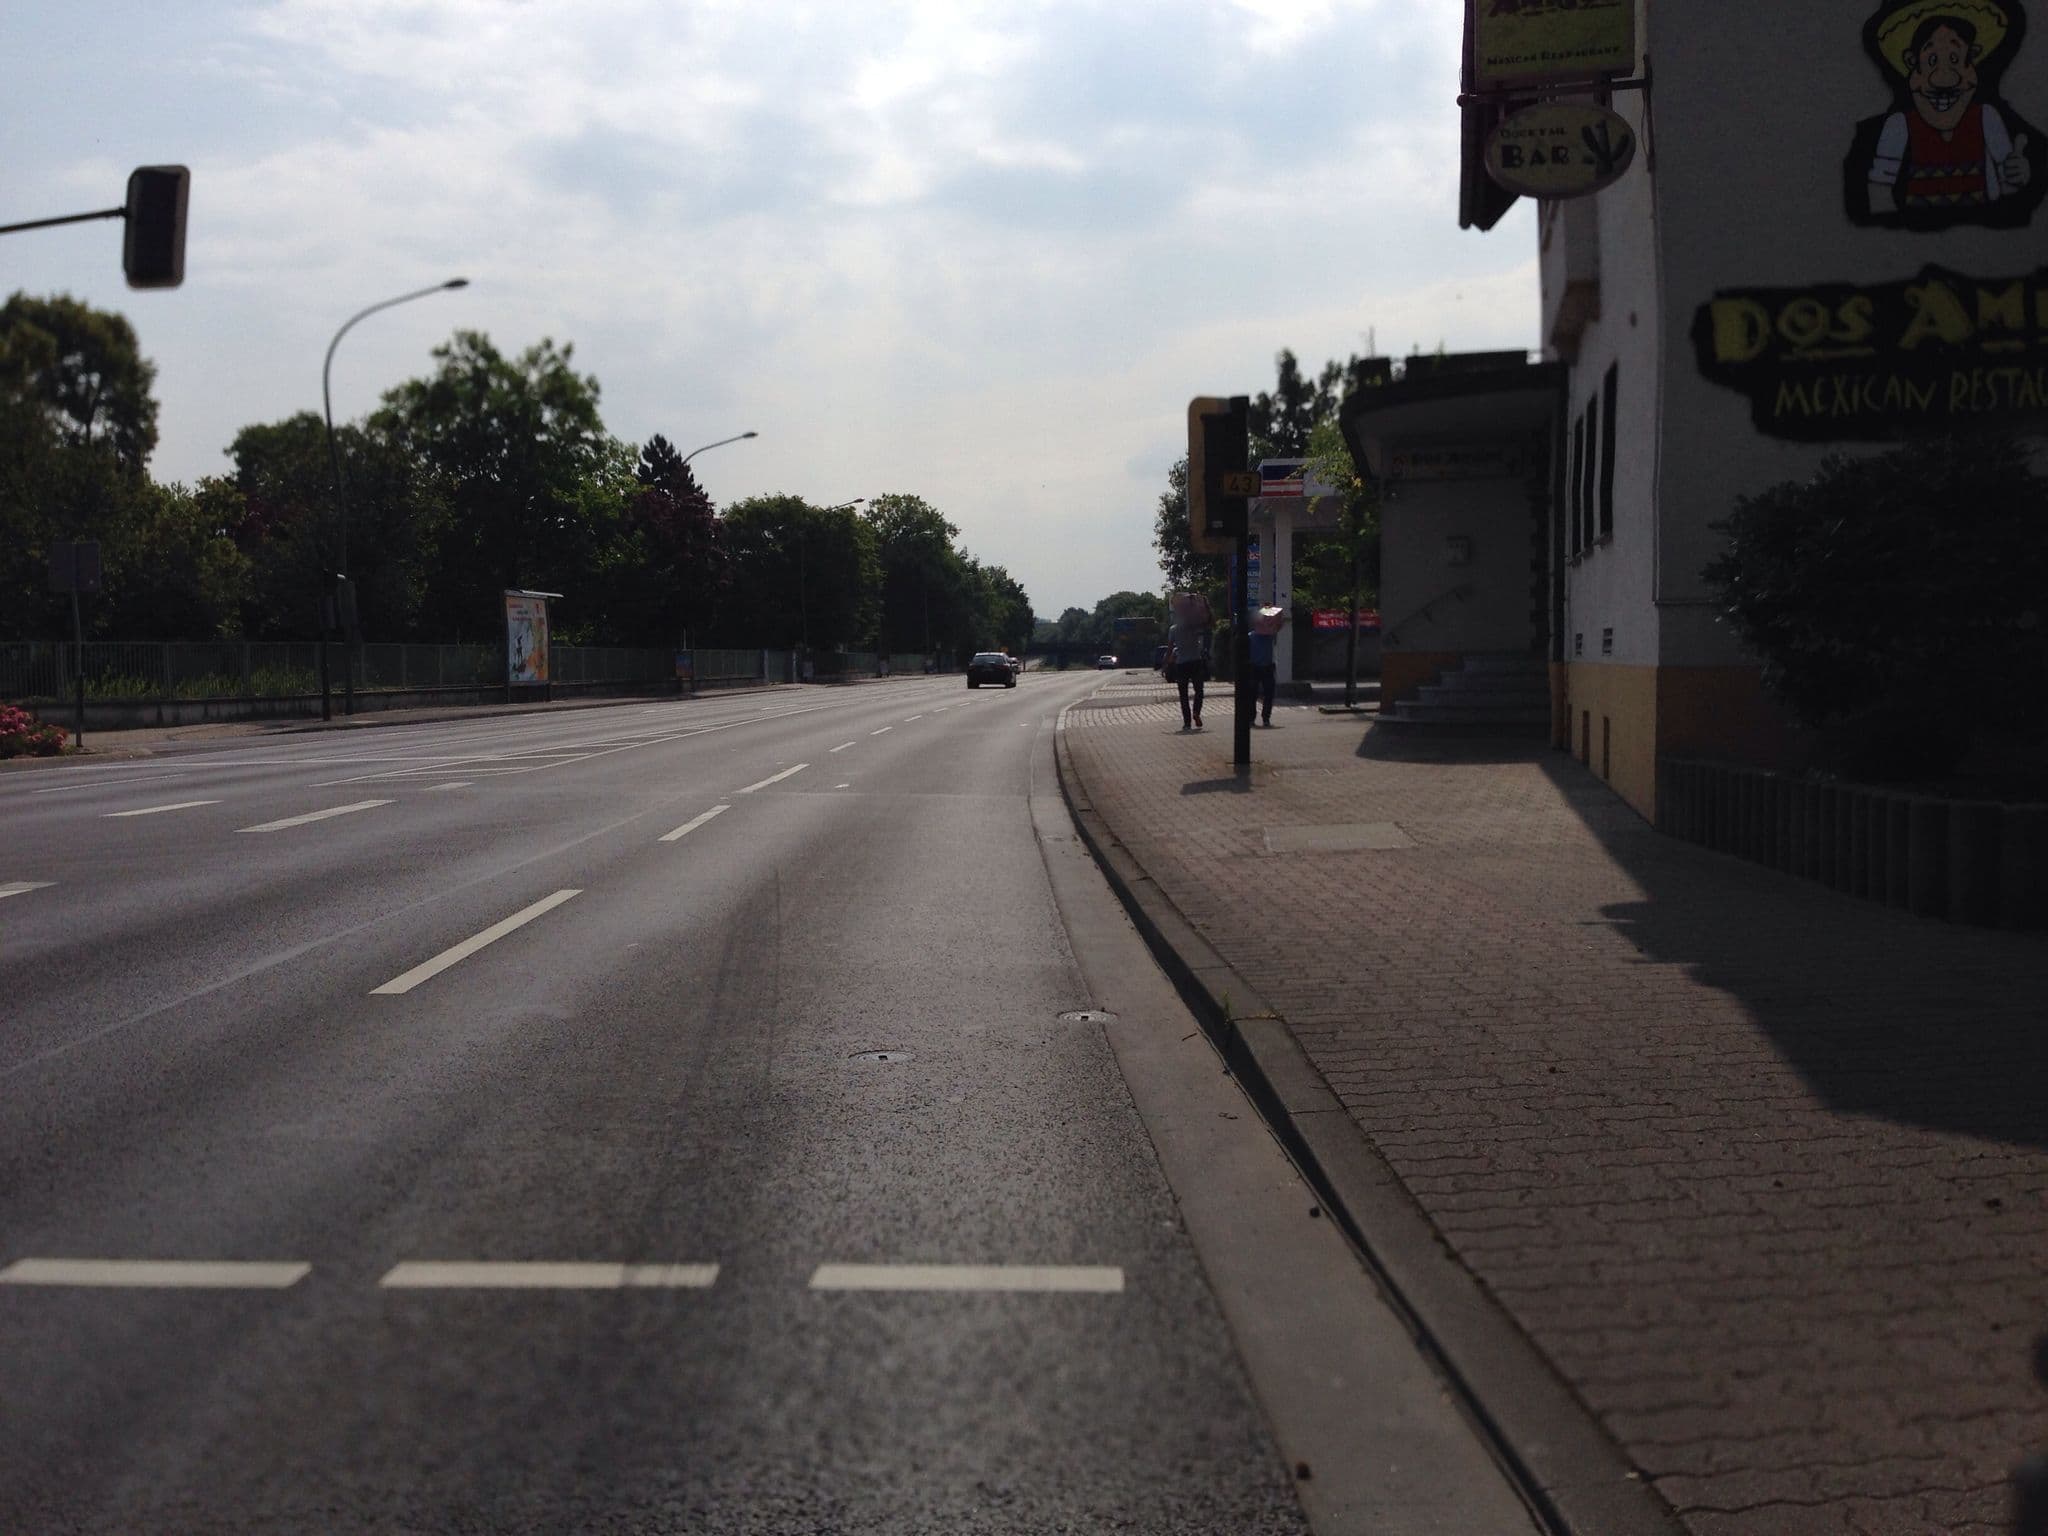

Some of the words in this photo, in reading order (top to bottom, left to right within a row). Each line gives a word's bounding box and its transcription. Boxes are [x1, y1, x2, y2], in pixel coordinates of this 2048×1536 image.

[1502, 145, 1569, 168] BAR
[1711, 295, 1873, 364] DOS
[1774, 376, 1939, 418] MEXICAN
